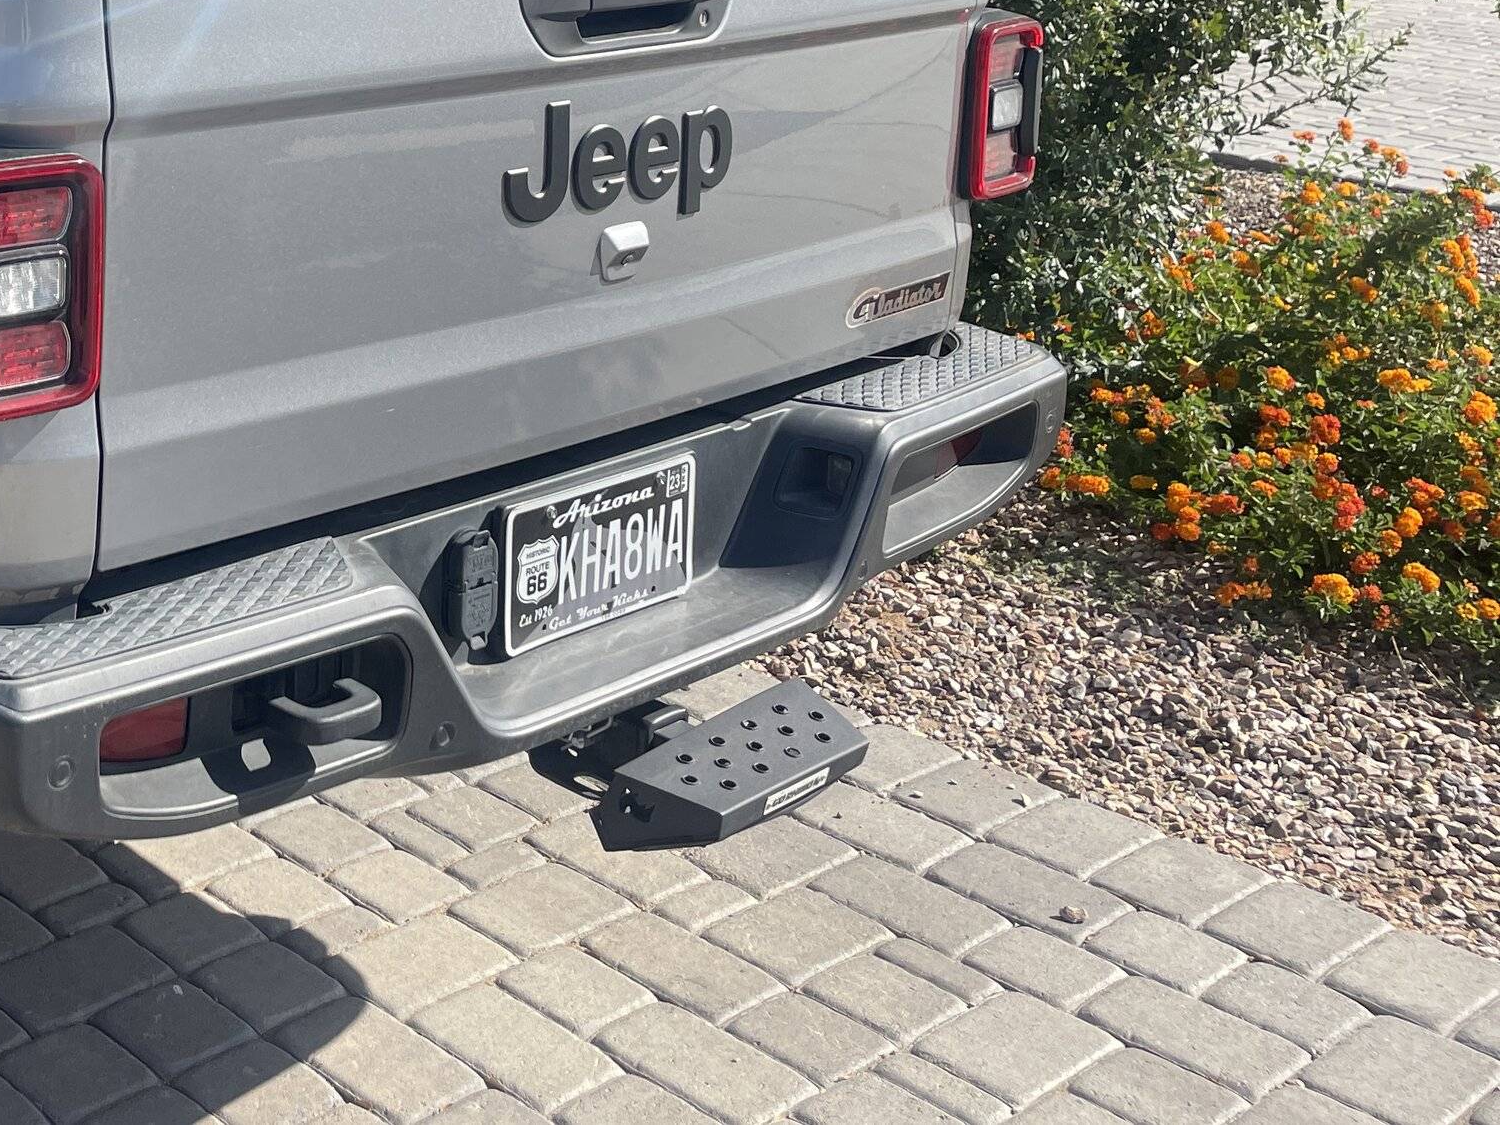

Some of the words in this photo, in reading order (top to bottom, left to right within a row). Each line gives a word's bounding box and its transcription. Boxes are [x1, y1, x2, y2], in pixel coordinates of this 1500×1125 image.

[501, 100, 733, 223] Jeep
[846, 283, 942, 327] Gladiator
[669, 474, 681, 490] 23
[553, 486, 654, 528] Arizona
[526, 547, 551, 559] HISTORIC
[557, 498, 683, 605] KHA8WA
[525, 561, 550, 576] ROUTE
[526, 572, 548, 596] 66
[534, 604, 553, 622] 1926
[549, 614, 572, 631] Get
[576, 602, 608, 620] Your
[612, 589, 649, 609] Kicks
